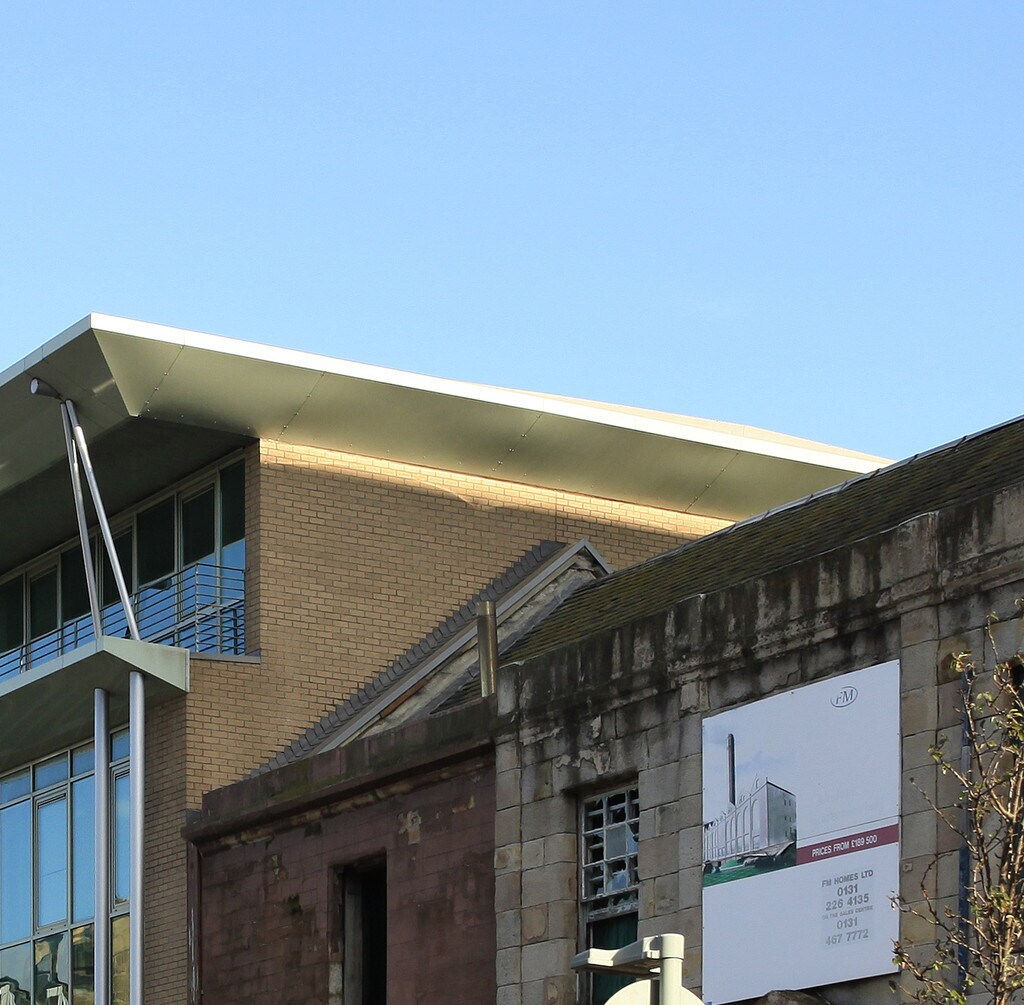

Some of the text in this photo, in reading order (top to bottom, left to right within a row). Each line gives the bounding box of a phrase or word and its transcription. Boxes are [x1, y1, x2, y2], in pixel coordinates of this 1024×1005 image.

[812, 845, 831, 857] PRICES
[833, 841, 850, 852] FROM
[834, 873, 858, 884] HOMES
[861, 870, 873, 879] LTD
[837, 883, 858, 897] 0131
[825, 893, 870, 911] 226 4135
[836, 917, 858, 930] 0131
[846, 928, 869, 942] 7772
